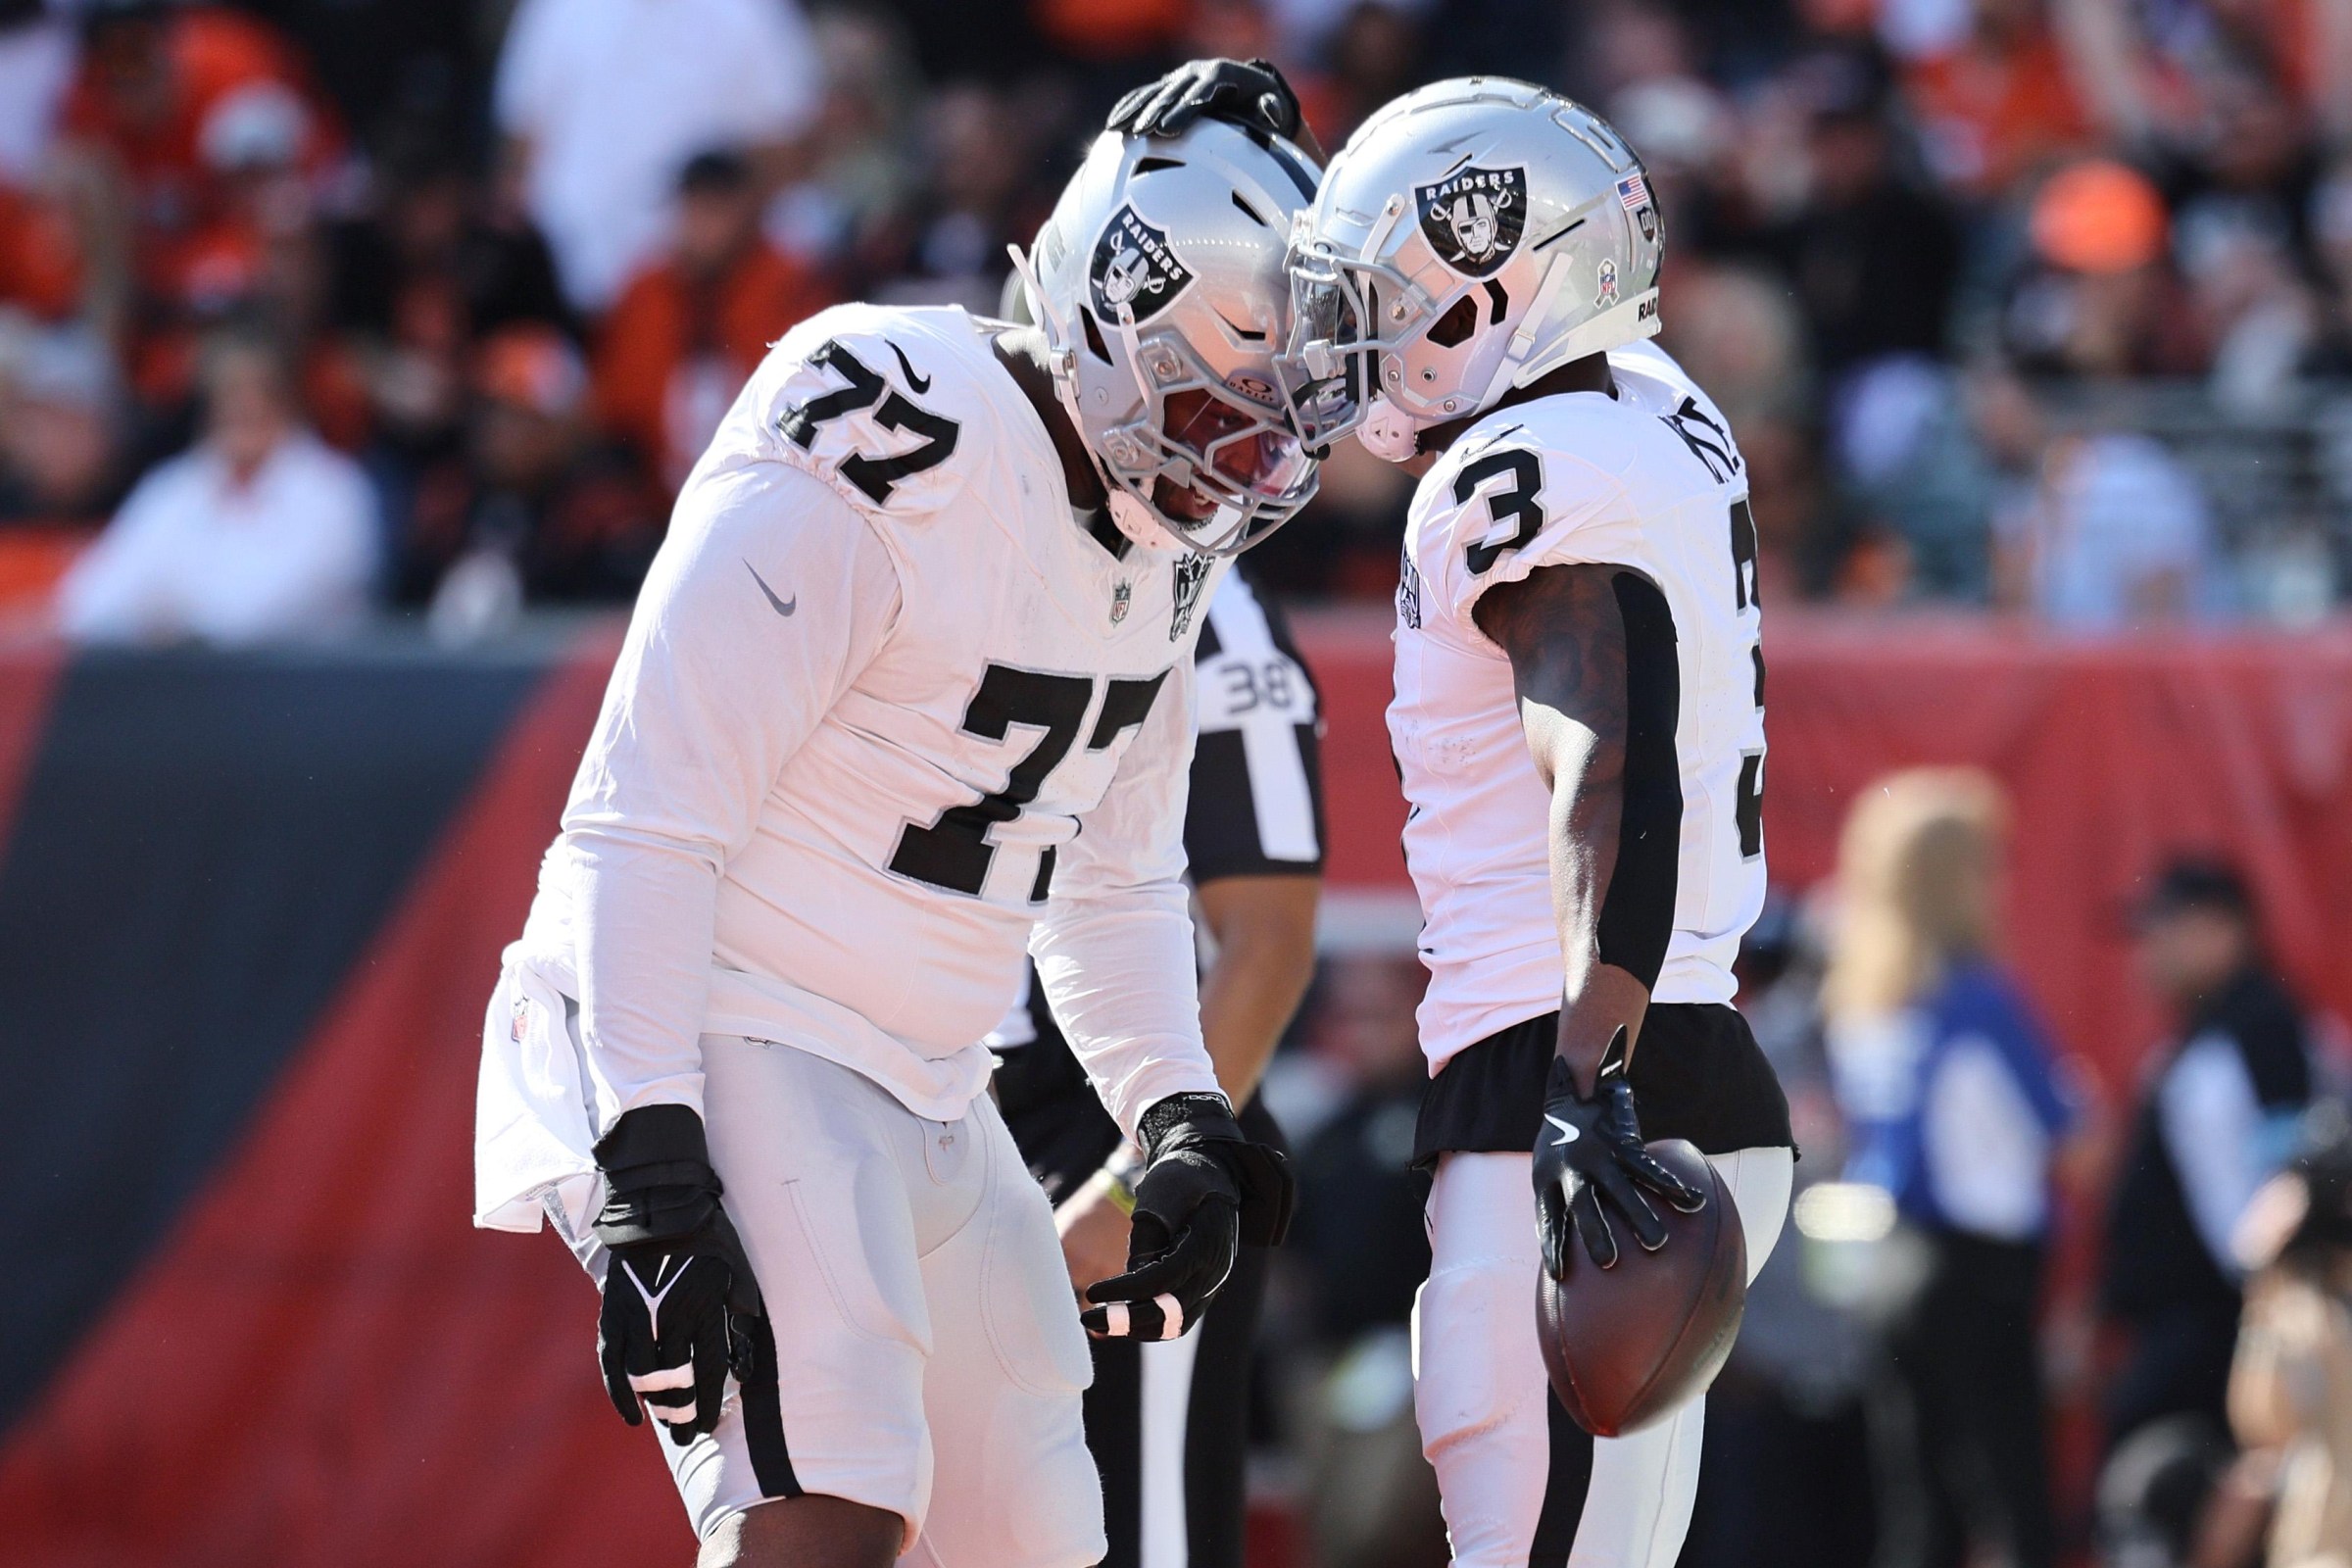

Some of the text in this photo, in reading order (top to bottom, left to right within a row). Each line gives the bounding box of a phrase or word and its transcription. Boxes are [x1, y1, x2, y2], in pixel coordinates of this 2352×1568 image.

[1425, 171, 1515, 201] RAIDERS
[1122, 213, 1184, 281] RAIDERS
[1229, 381, 1274, 402] OAKLEY
[773, 336, 962, 509] 77
[1450, 447, 1548, 580] 3
[1221, 662, 1292, 713] 38
